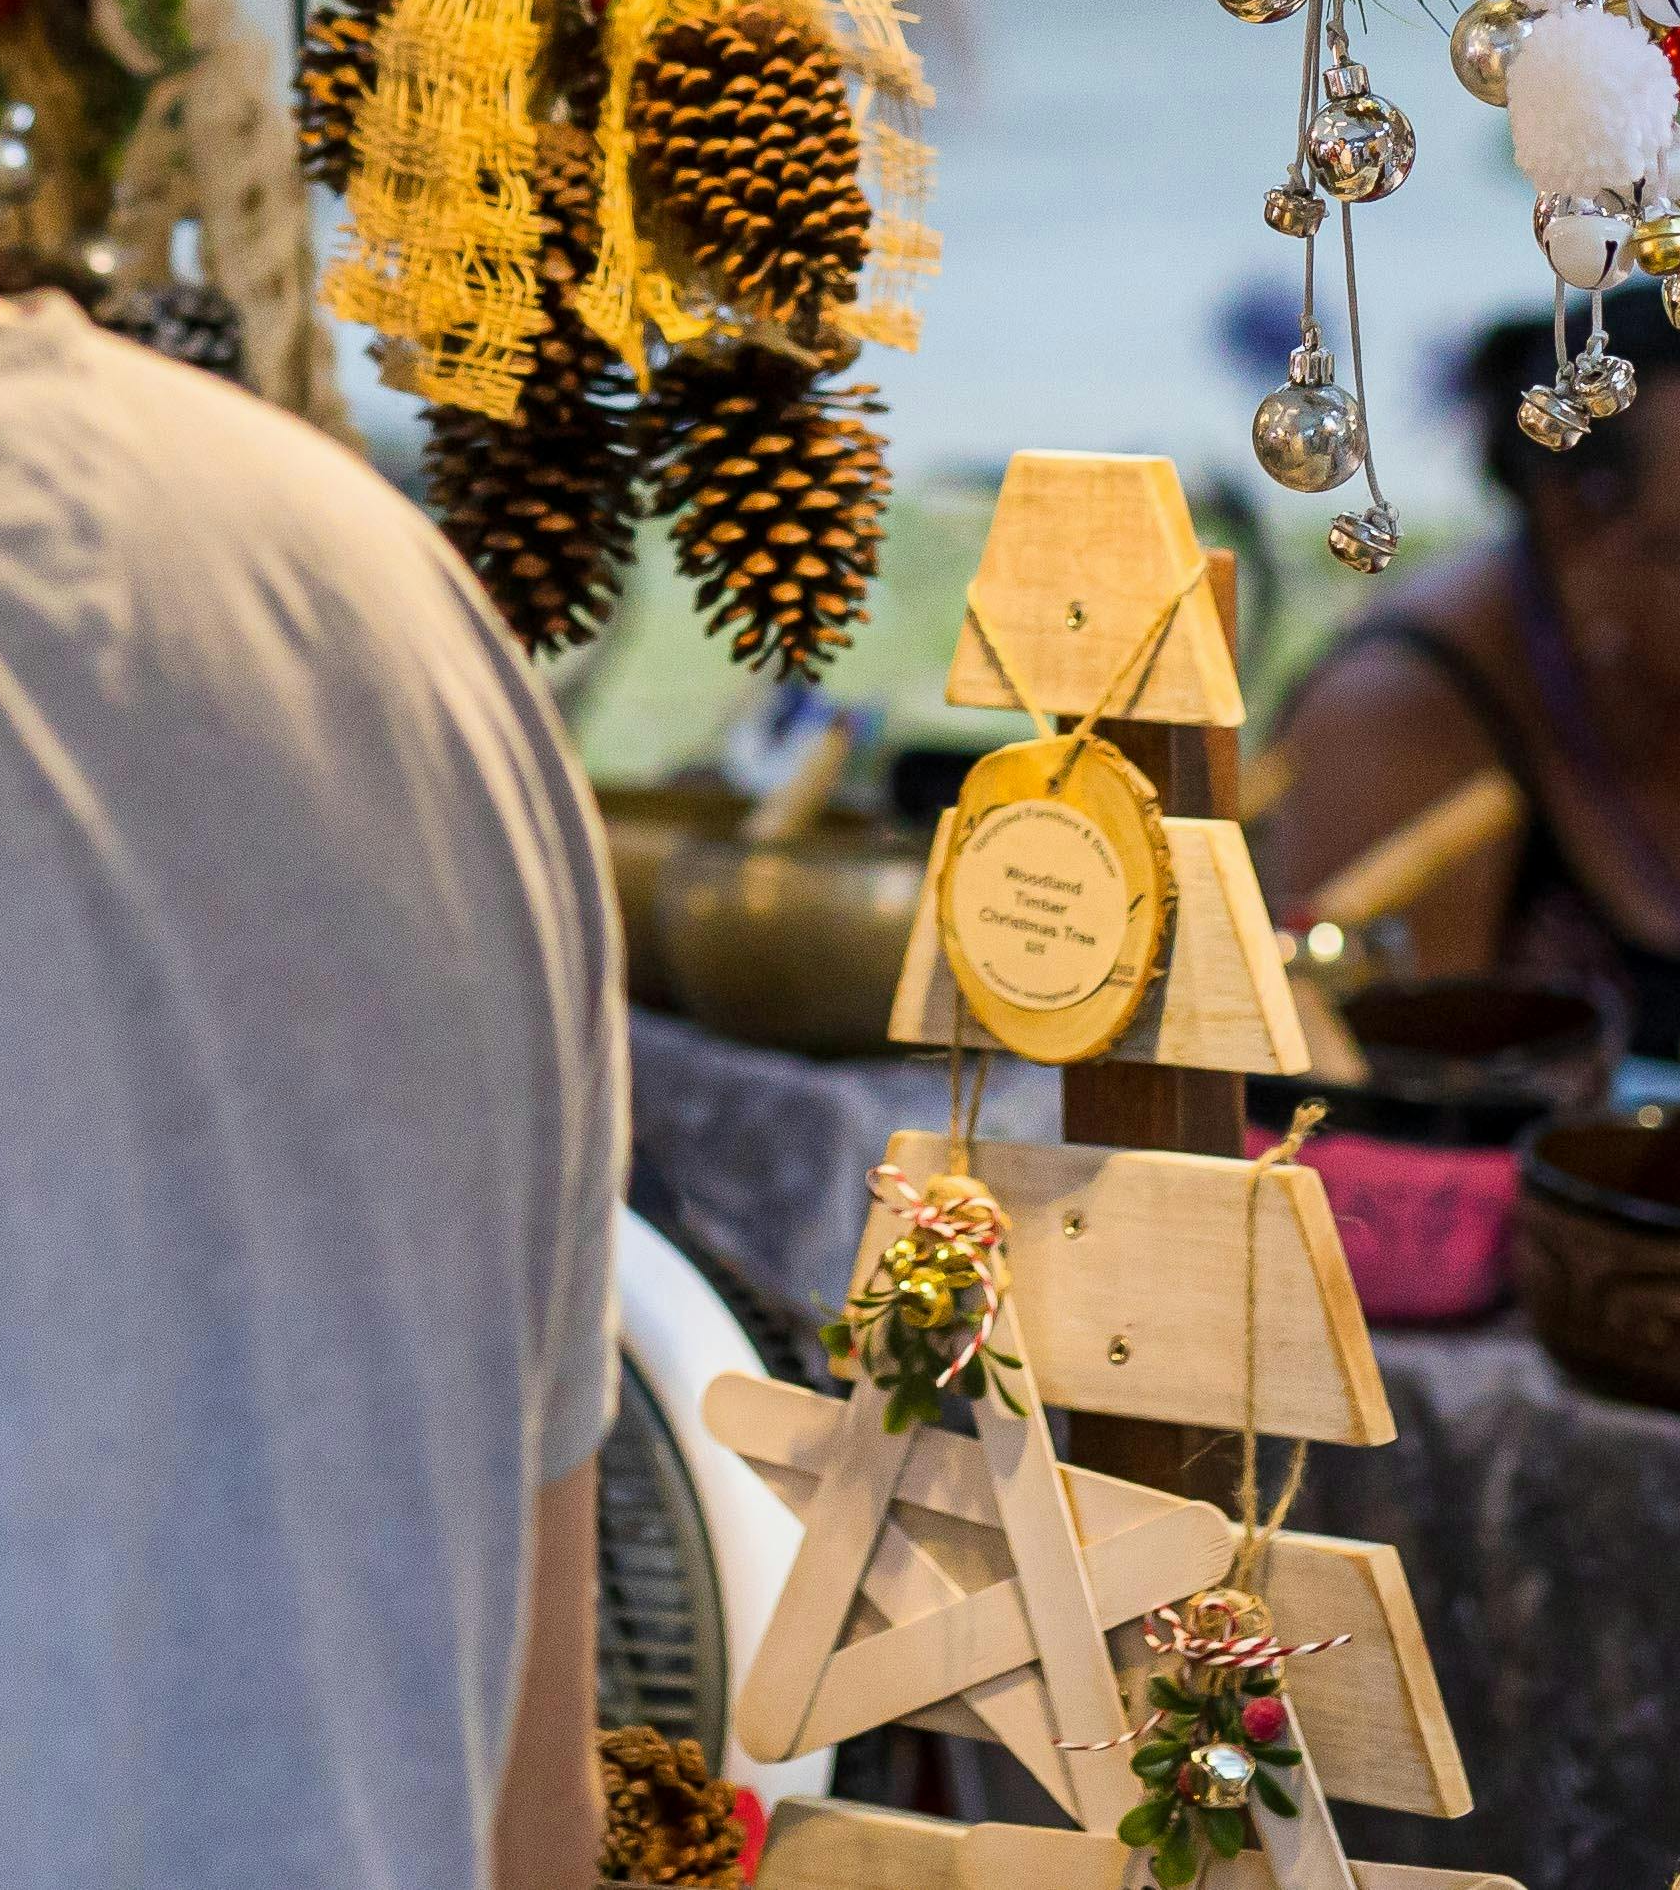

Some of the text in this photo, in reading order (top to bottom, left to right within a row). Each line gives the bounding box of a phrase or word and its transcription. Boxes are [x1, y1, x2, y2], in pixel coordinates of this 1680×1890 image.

[1004, 864, 1083, 896] Woodland
[1015, 889, 1069, 914] Timber
[978, 906, 1097, 946] Christmas Tree
